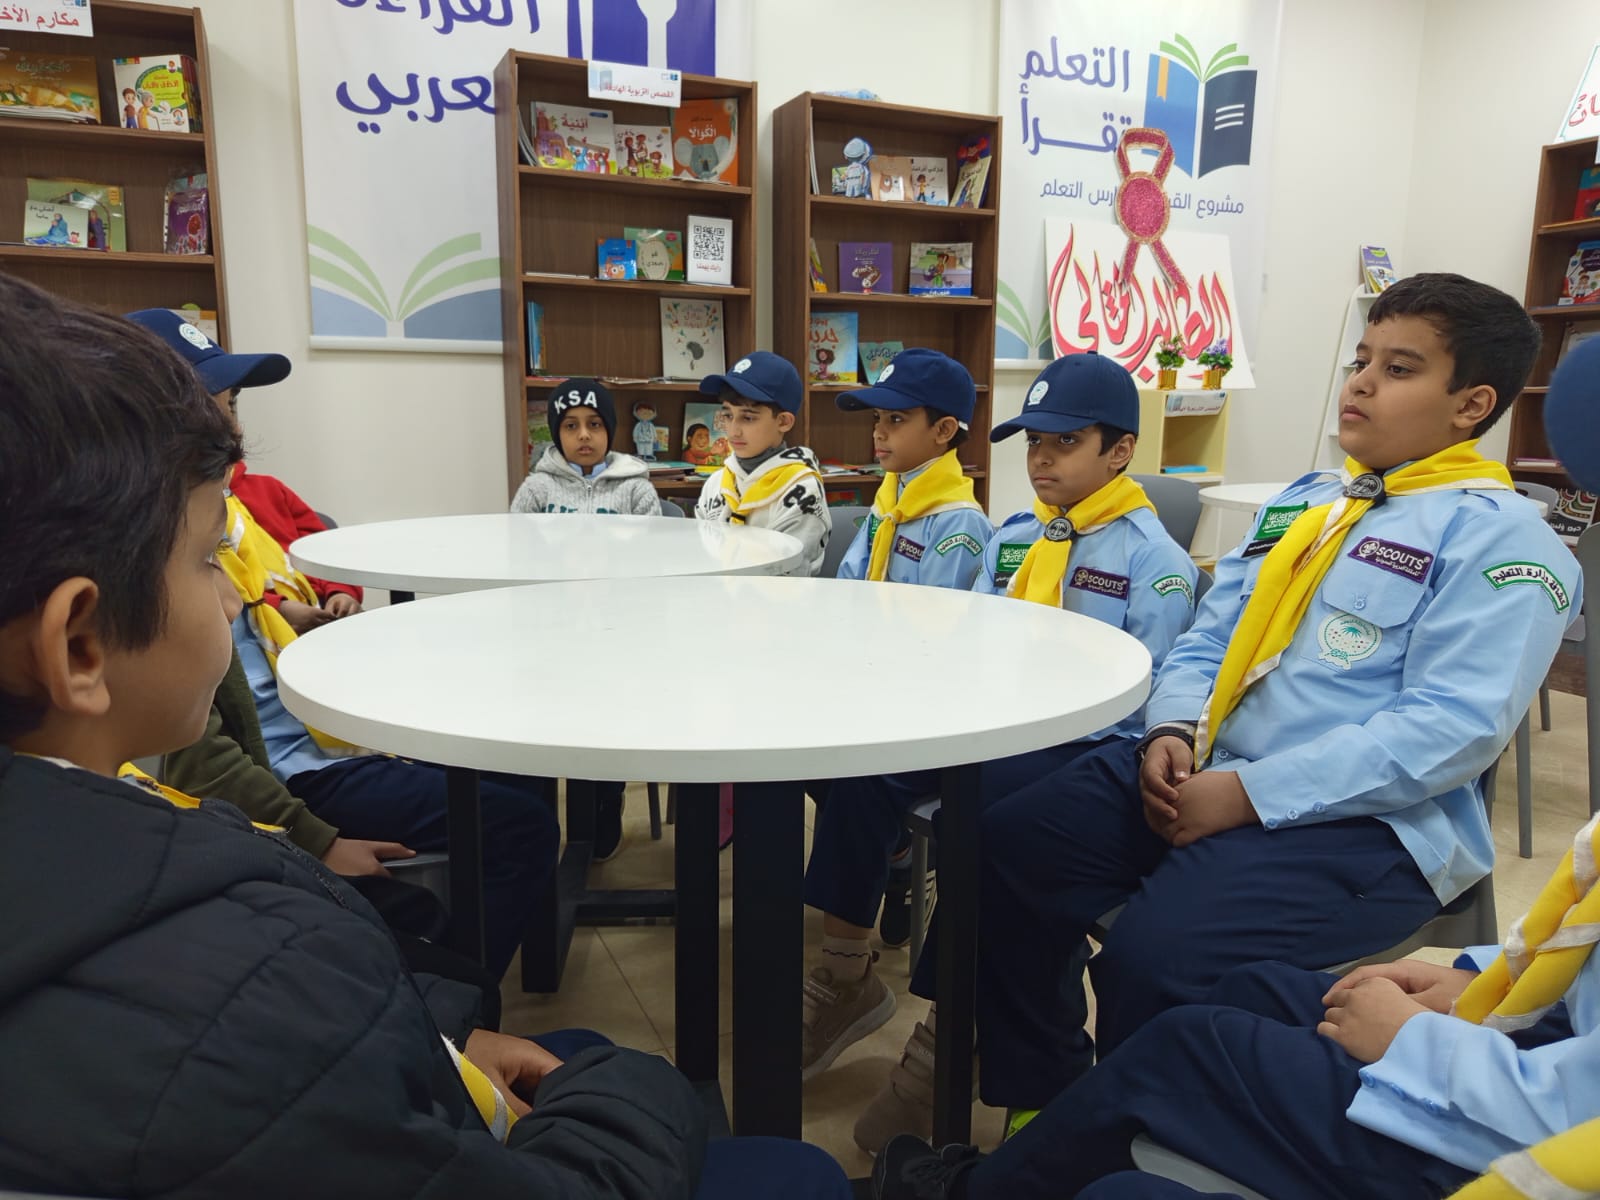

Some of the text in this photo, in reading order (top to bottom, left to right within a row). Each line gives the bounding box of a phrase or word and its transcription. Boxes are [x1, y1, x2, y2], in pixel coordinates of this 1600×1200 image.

[0, 4, 80, 30] مكارم الأخ
[1017, 35, 1130, 93] التعلم
[336, 73, 496, 134] عربي
[1040, 178, 1244, 218] مشروع الق ارس التعلم
[554, 390, 598, 415] KSA
[906, 543, 922, 557] SCOU
[1376, 546, 1424, 570] SCOUTS
[1087, 574, 1124, 591] SCOUTS
[1493, 567, 1566, 606] كشافة وزارة التعليم
